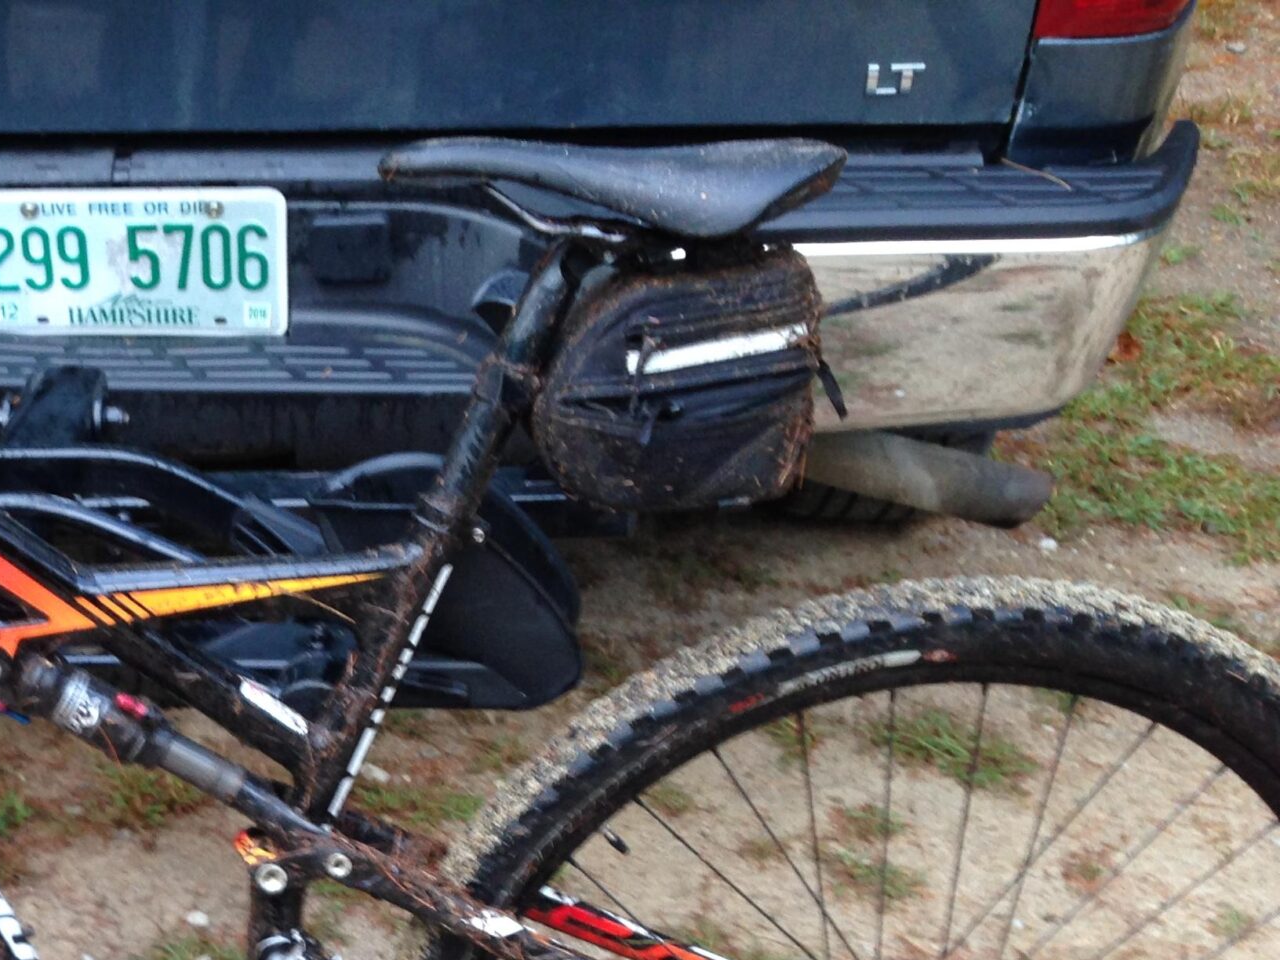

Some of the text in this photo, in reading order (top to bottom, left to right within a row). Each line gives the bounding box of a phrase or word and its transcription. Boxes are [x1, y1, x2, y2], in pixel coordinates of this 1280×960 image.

[866, 62, 926, 95] LT
[40, 202, 77, 217] LIVE
[87, 202, 134, 217] FREE
[144, 201, 170, 216] OR
[125, 223, 270, 291] 5706
[0, 303, 19, 321] 12
[67, 305, 203, 326] HAMPSHIRE
